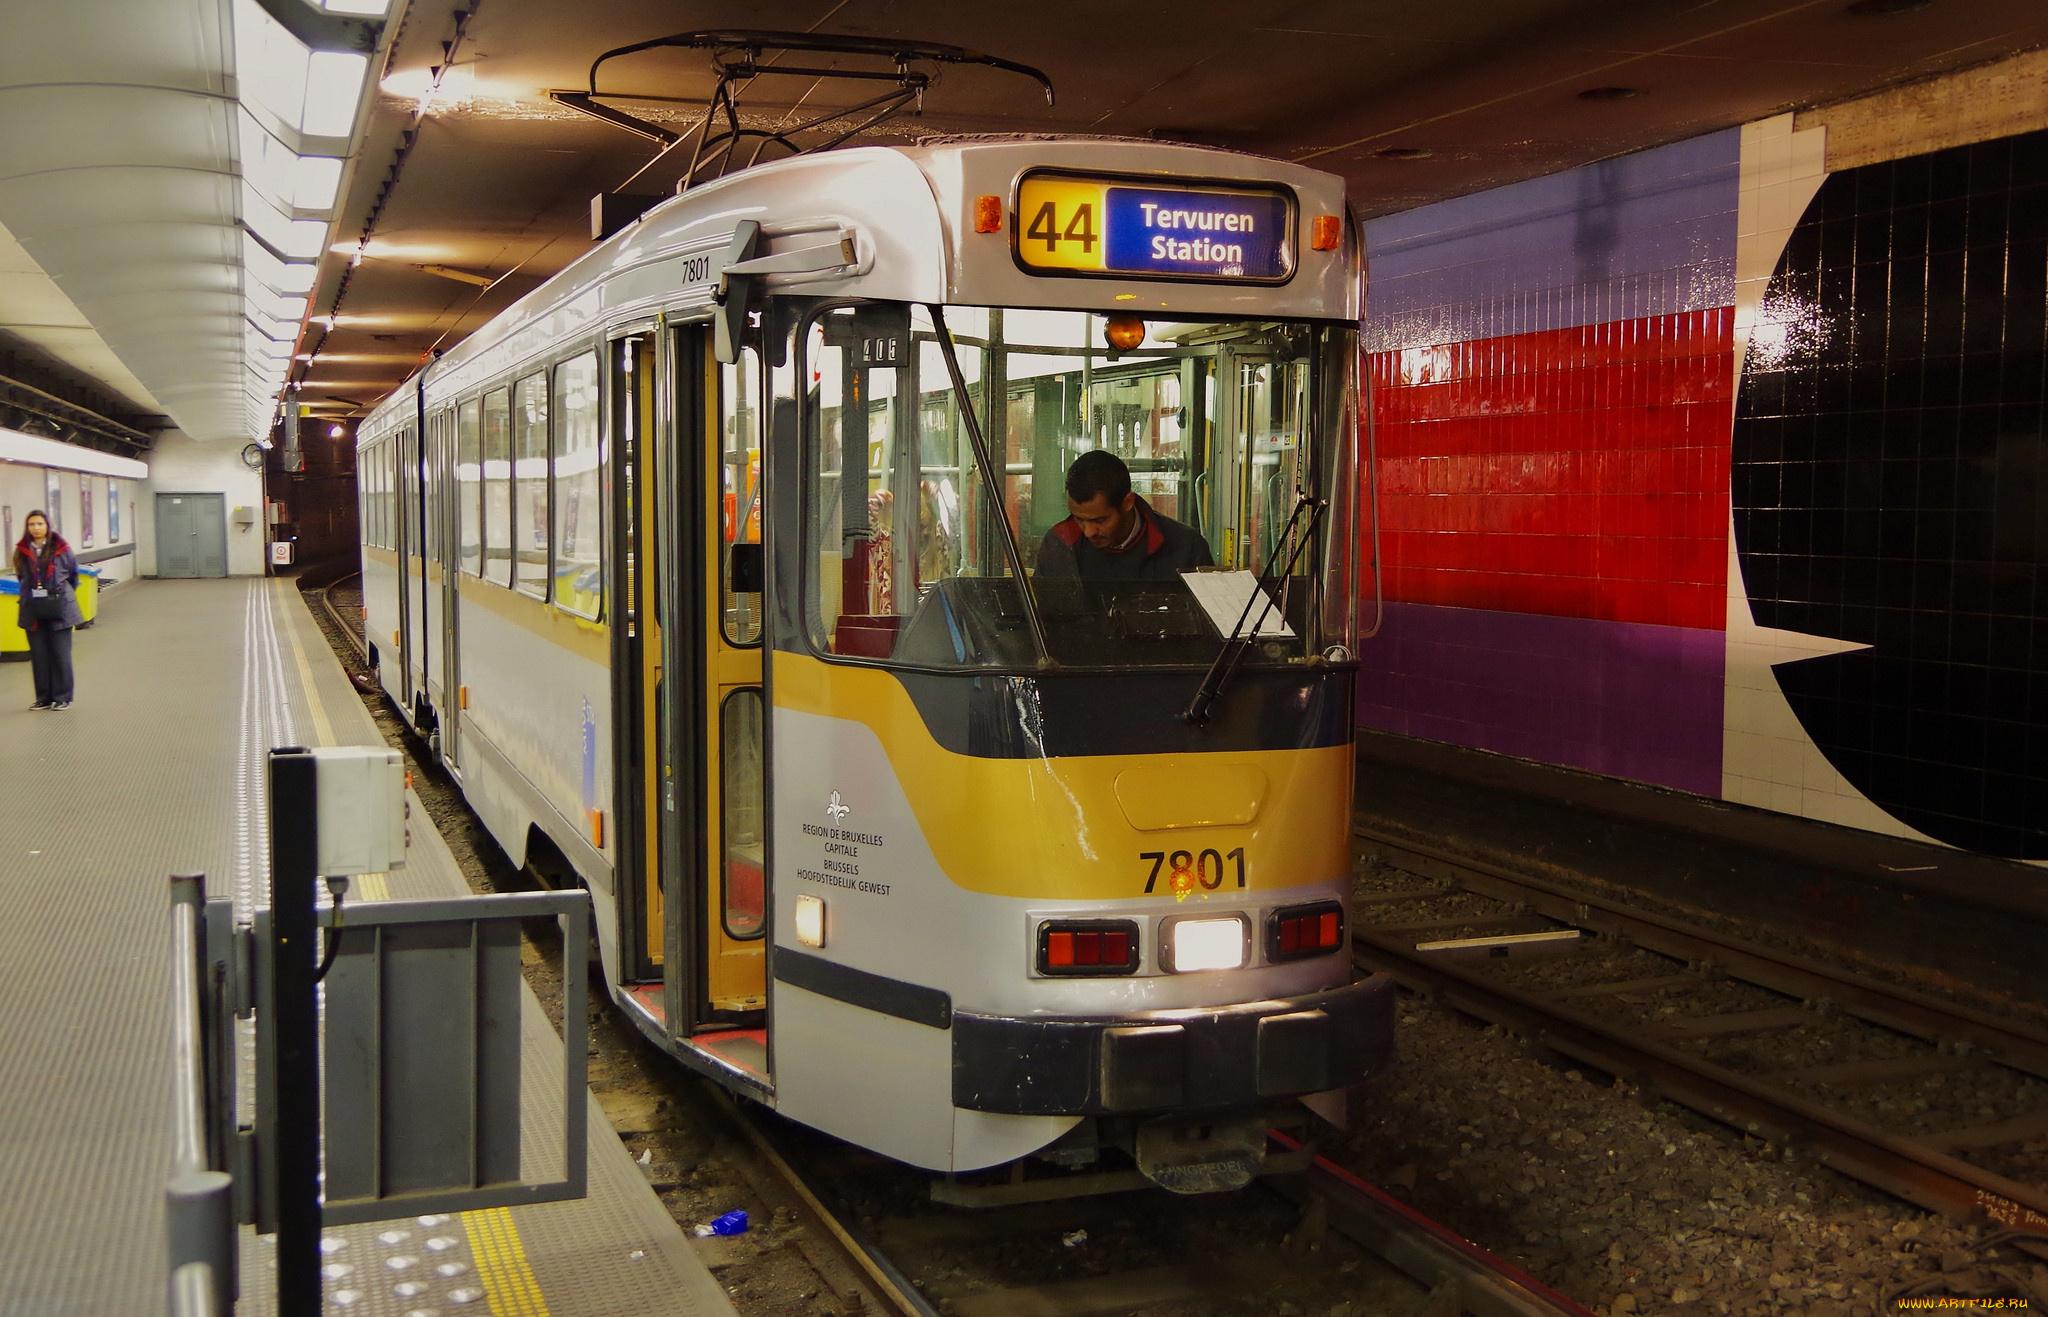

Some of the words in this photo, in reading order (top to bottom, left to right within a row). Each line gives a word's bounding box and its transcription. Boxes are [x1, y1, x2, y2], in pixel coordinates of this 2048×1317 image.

[1026, 201, 1098, 253] 44
[1140, 203, 1254, 232] Tervuren
[1151, 236, 1243, 263] Station
[682, 256, 710, 284] 7801
[802, 823, 829, 838] REGION
[830, 828, 840, 840] DE
[841, 830, 883, 847] BRUXELLES
[824, 842, 858, 857] CAPITALE
[823, 859, 859, 875] BRUSSELS
[1139, 847, 1247, 893] 7801
[797, 868, 857, 890] HOOFDSTEDELIJK
[858, 880, 891, 896] GEWEST
